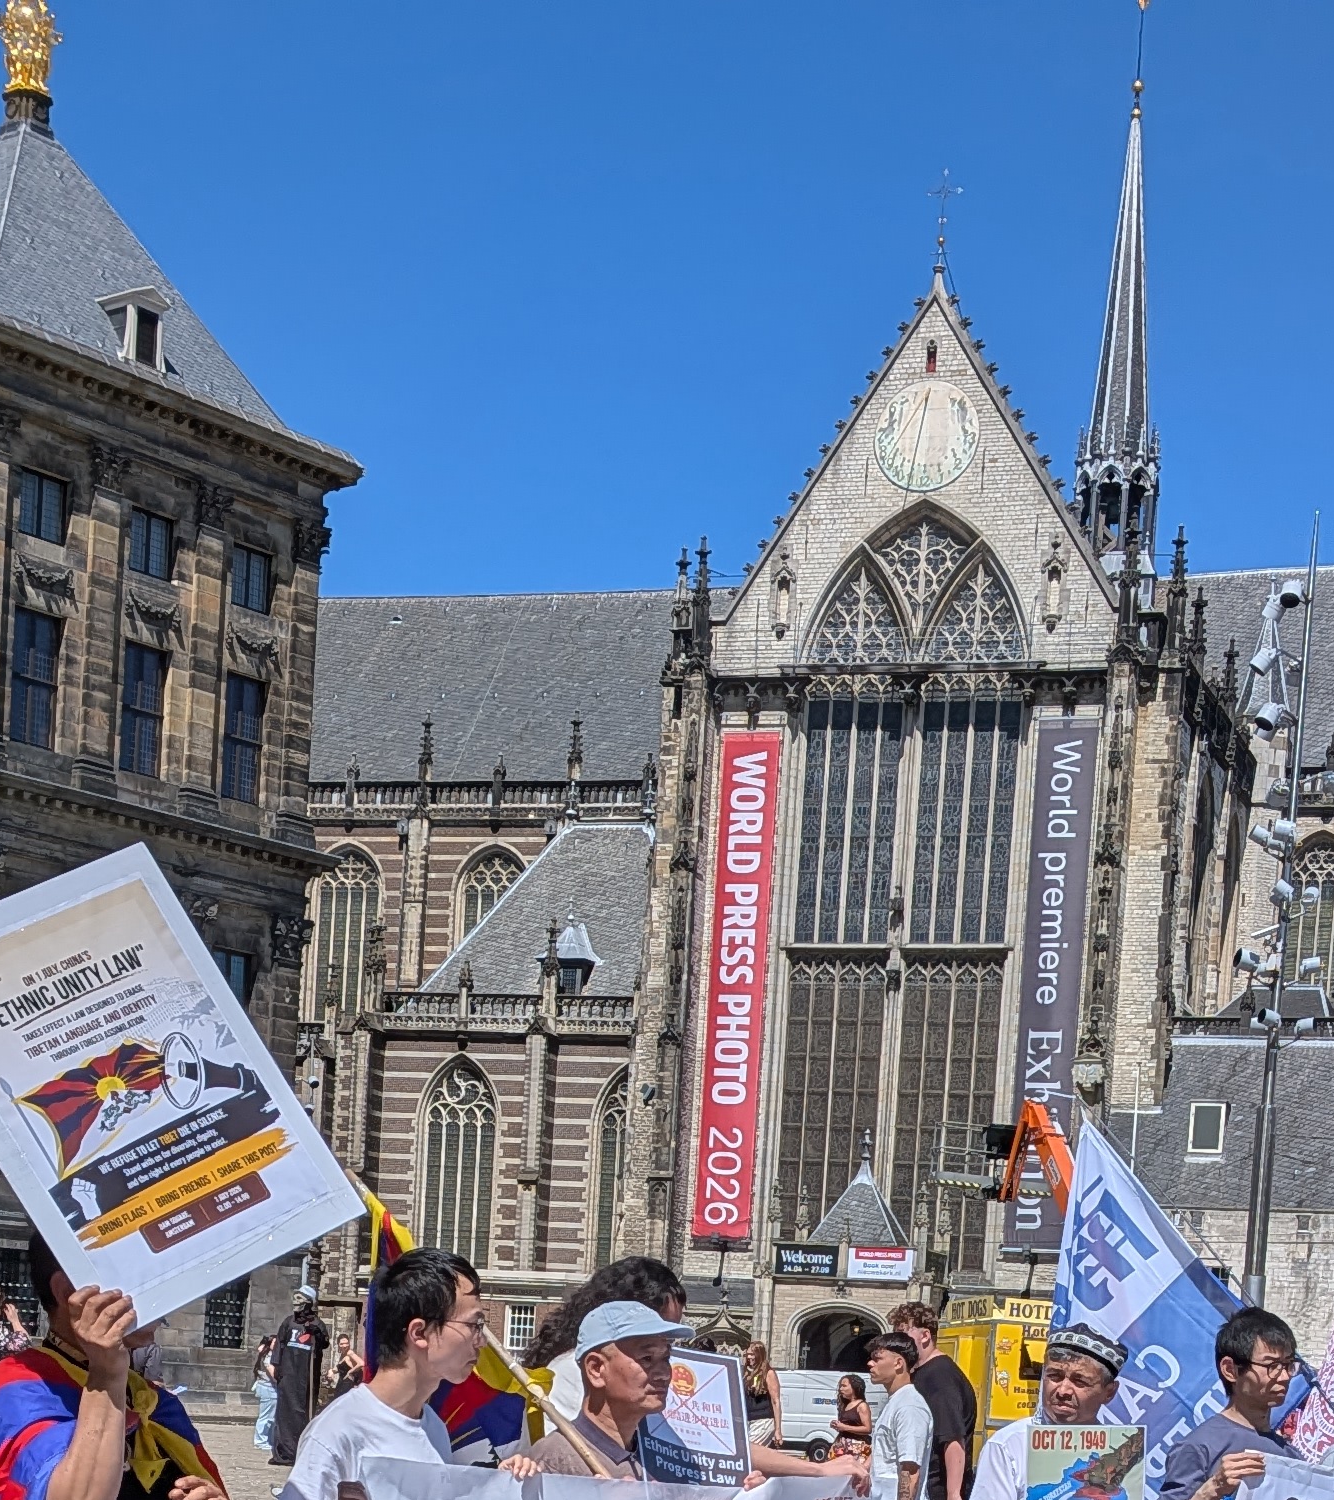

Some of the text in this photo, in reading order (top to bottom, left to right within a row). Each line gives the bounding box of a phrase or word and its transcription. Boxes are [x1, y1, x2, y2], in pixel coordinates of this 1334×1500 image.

[1047, 738, 1084, 838] World
[1035, 849, 1070, 1006] premiere
[21, 949, 92, 986] ON 1 JULY, CHINA'S
[51, 962, 107, 1000] UNITY
[100, 943, 151, 978] LAW"
[703, 750, 768, 1227] WORLD PRESS PHOTO 2026
[21, 983, 145, 1042] TAKES EFFECT A LAW DESIGNED TO ERASE
[23, 994, 158, 1059] TIBETAN LANGUAGE AND IDENTITY
[49, 1043, 81, 1062] THROUGH
[78, 1033, 105, 1049] FORCED
[97, 1107, 229, 1174] WE REFUSE TO LET TIBET DIE IN SILENCE.
[215, 1159, 244, 1178] SHARE
[240, 1150, 261, 1166] THIS
[153, 1174, 213, 1208] BRING FRIENDS
[96, 1205, 149, 1235] BRING FLAGS
[781, 1250, 833, 1264] Welcome
[952, 1299, 986, 1319] HOT DOGS
[643, 1436, 744, 1471] Ethnic Unity and
[1032, 1430, 1107, 1452] OCT 12, 1949
[655, 1456, 737, 1485] Progress Law
